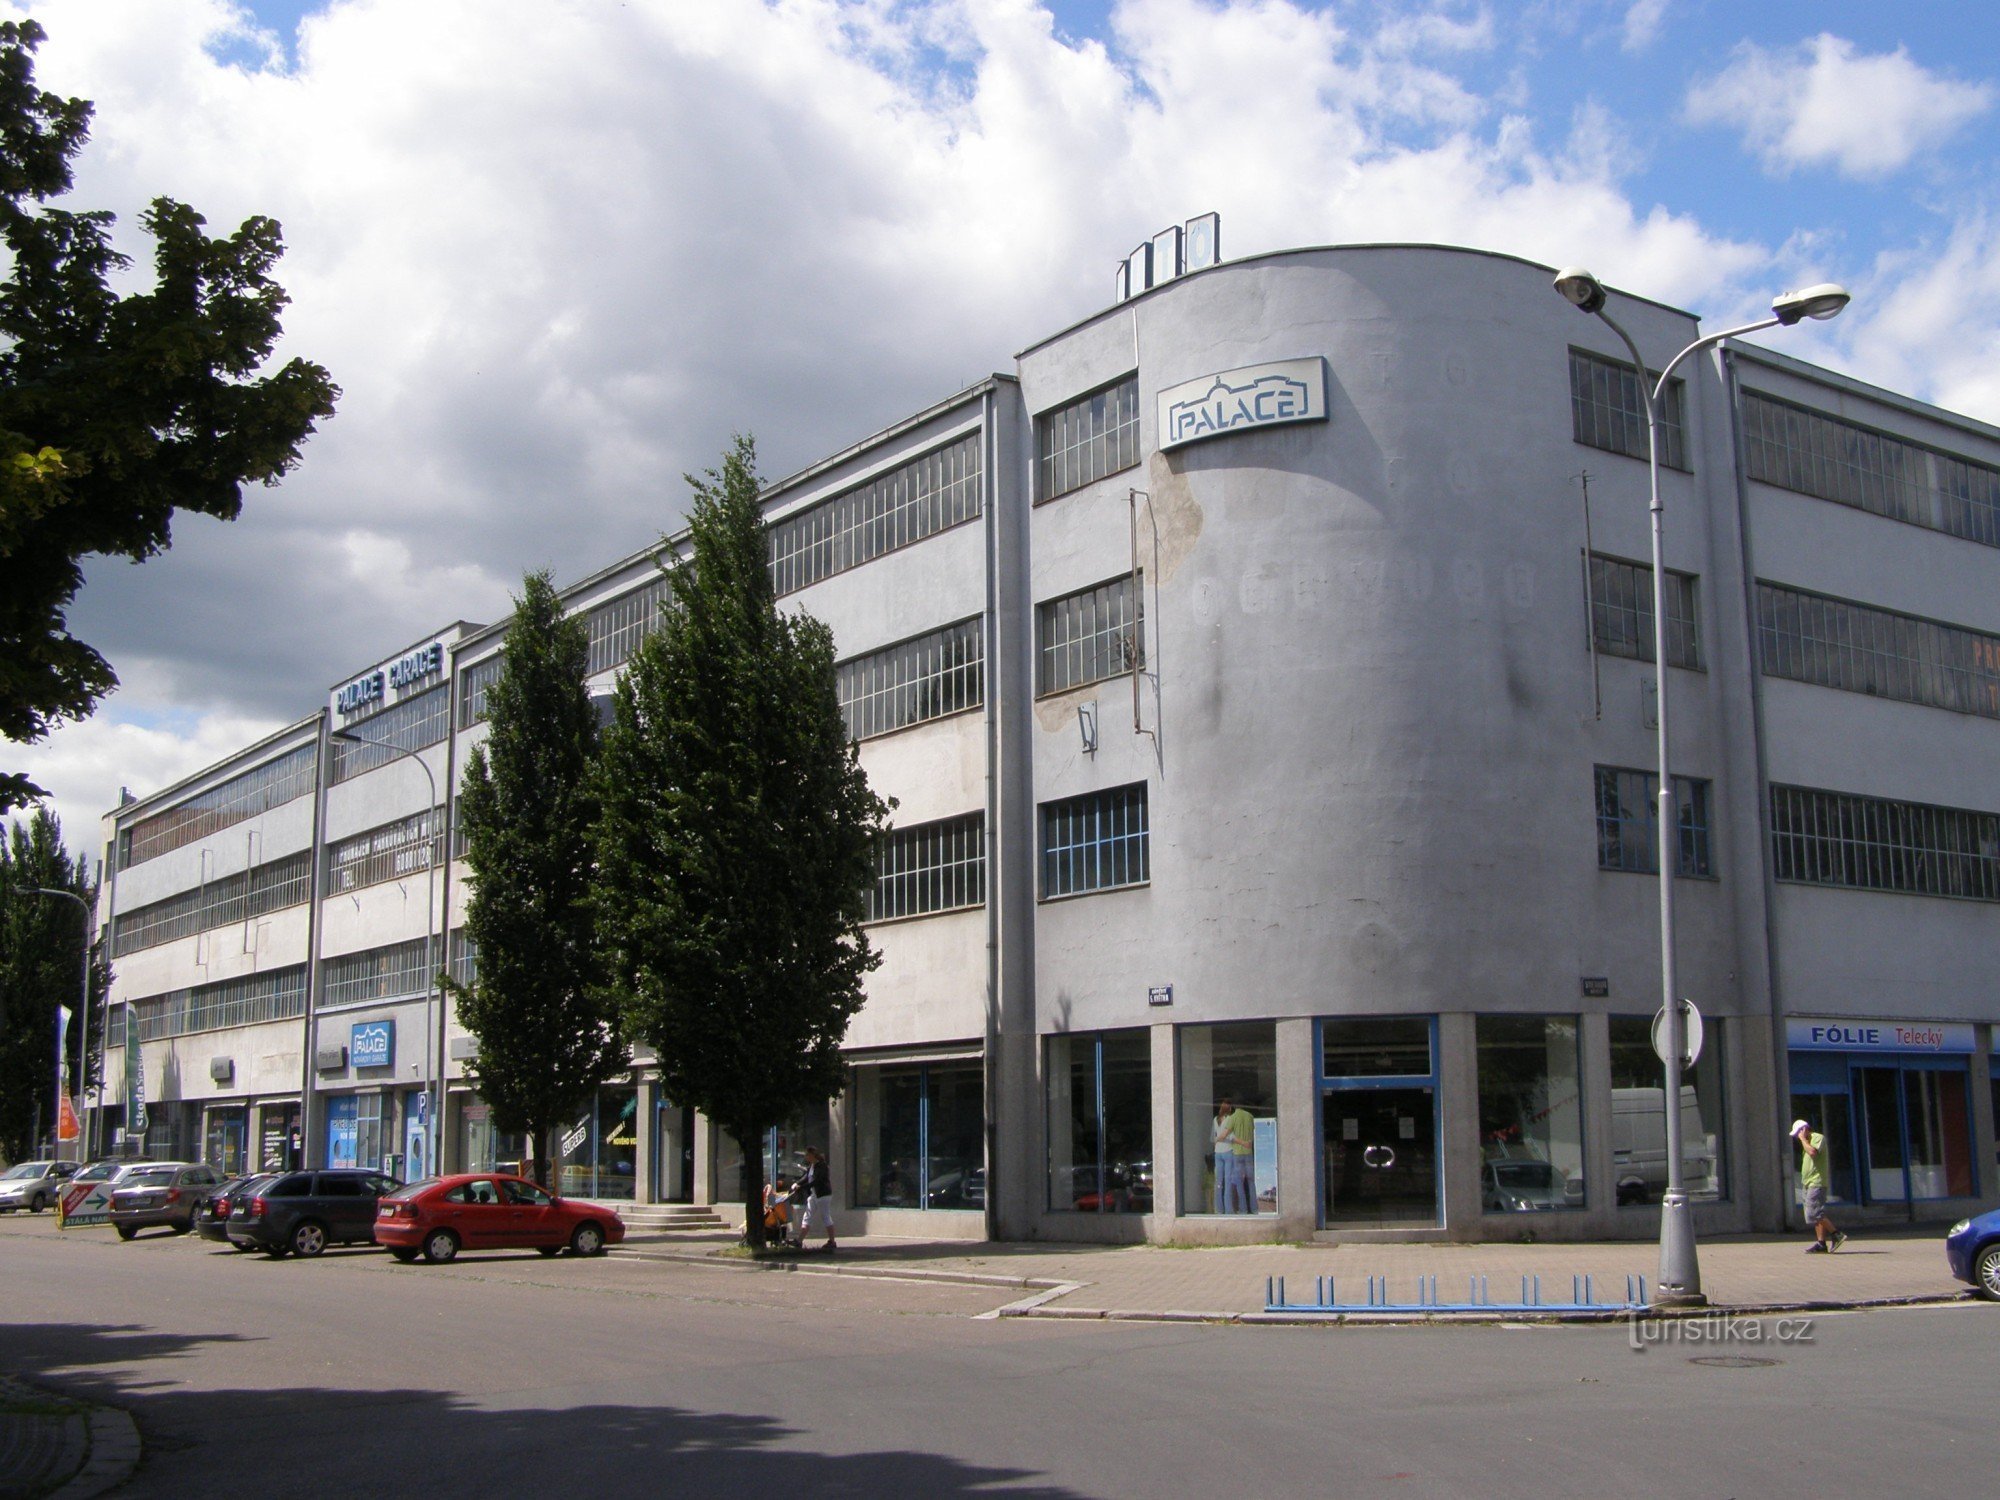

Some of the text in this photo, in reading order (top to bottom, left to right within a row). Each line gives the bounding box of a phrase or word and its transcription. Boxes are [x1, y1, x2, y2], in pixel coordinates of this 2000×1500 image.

[1177, 390, 1296, 440] PALACE
[336, 642, 443, 715] PALACE GARAGE
[356, 1038, 385, 1054] PALACE
[1811, 1023, 1943, 1051] FÓLIE Telecký
[562, 1126, 587, 1157] SUPERB
